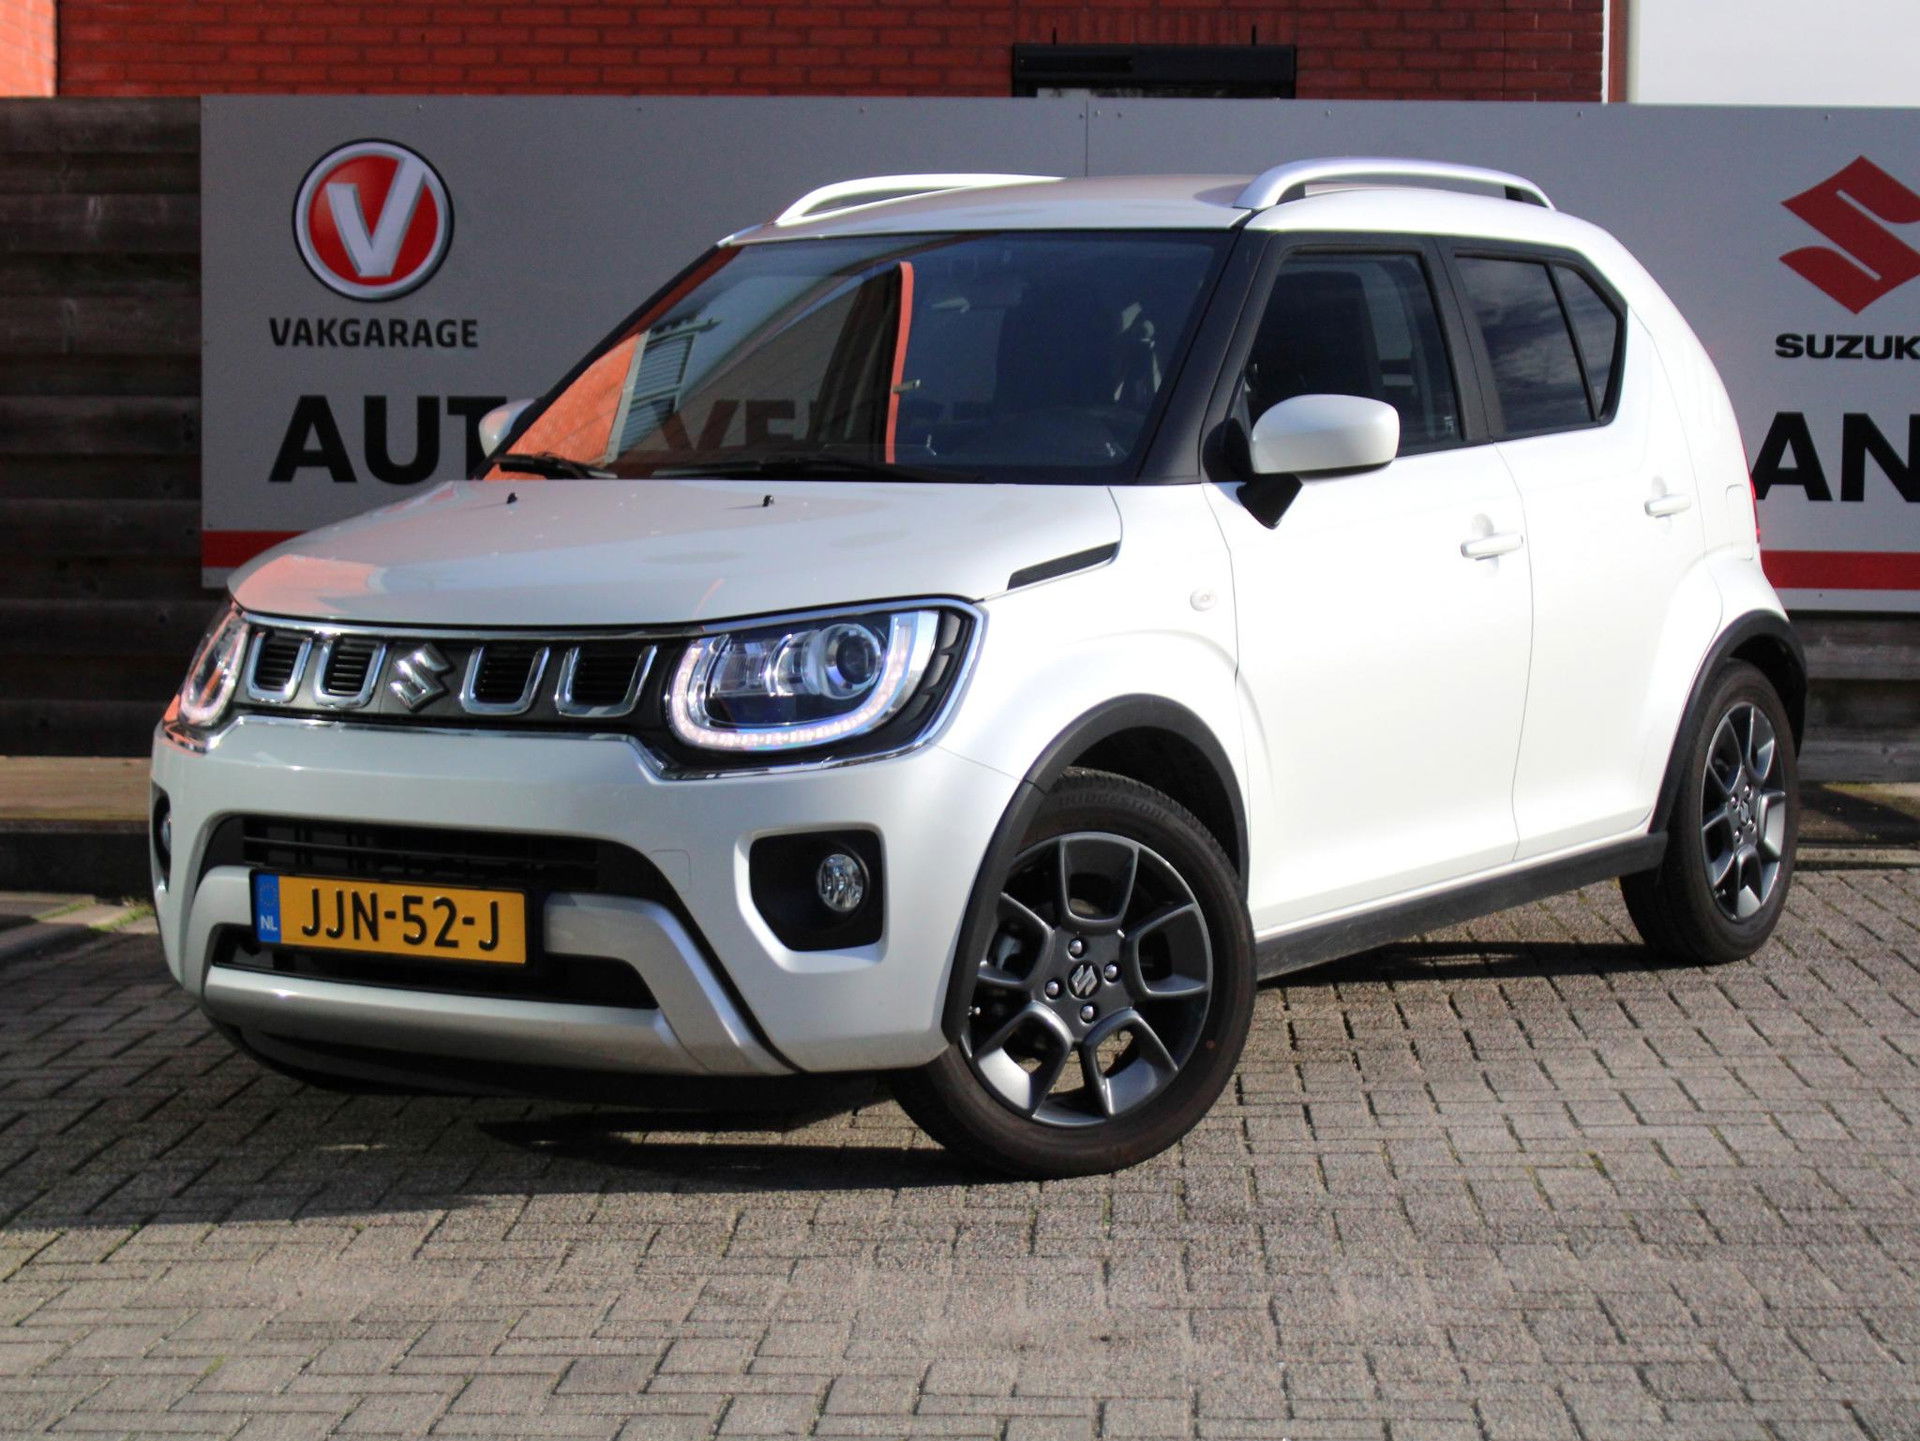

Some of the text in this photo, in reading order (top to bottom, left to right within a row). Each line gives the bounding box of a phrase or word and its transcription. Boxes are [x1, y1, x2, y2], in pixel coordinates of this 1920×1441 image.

[269, 317, 479, 348] VAKGARAGE
[260, 915, 277, 931] NL
[301, 886, 499, 951] JJN-52-J
